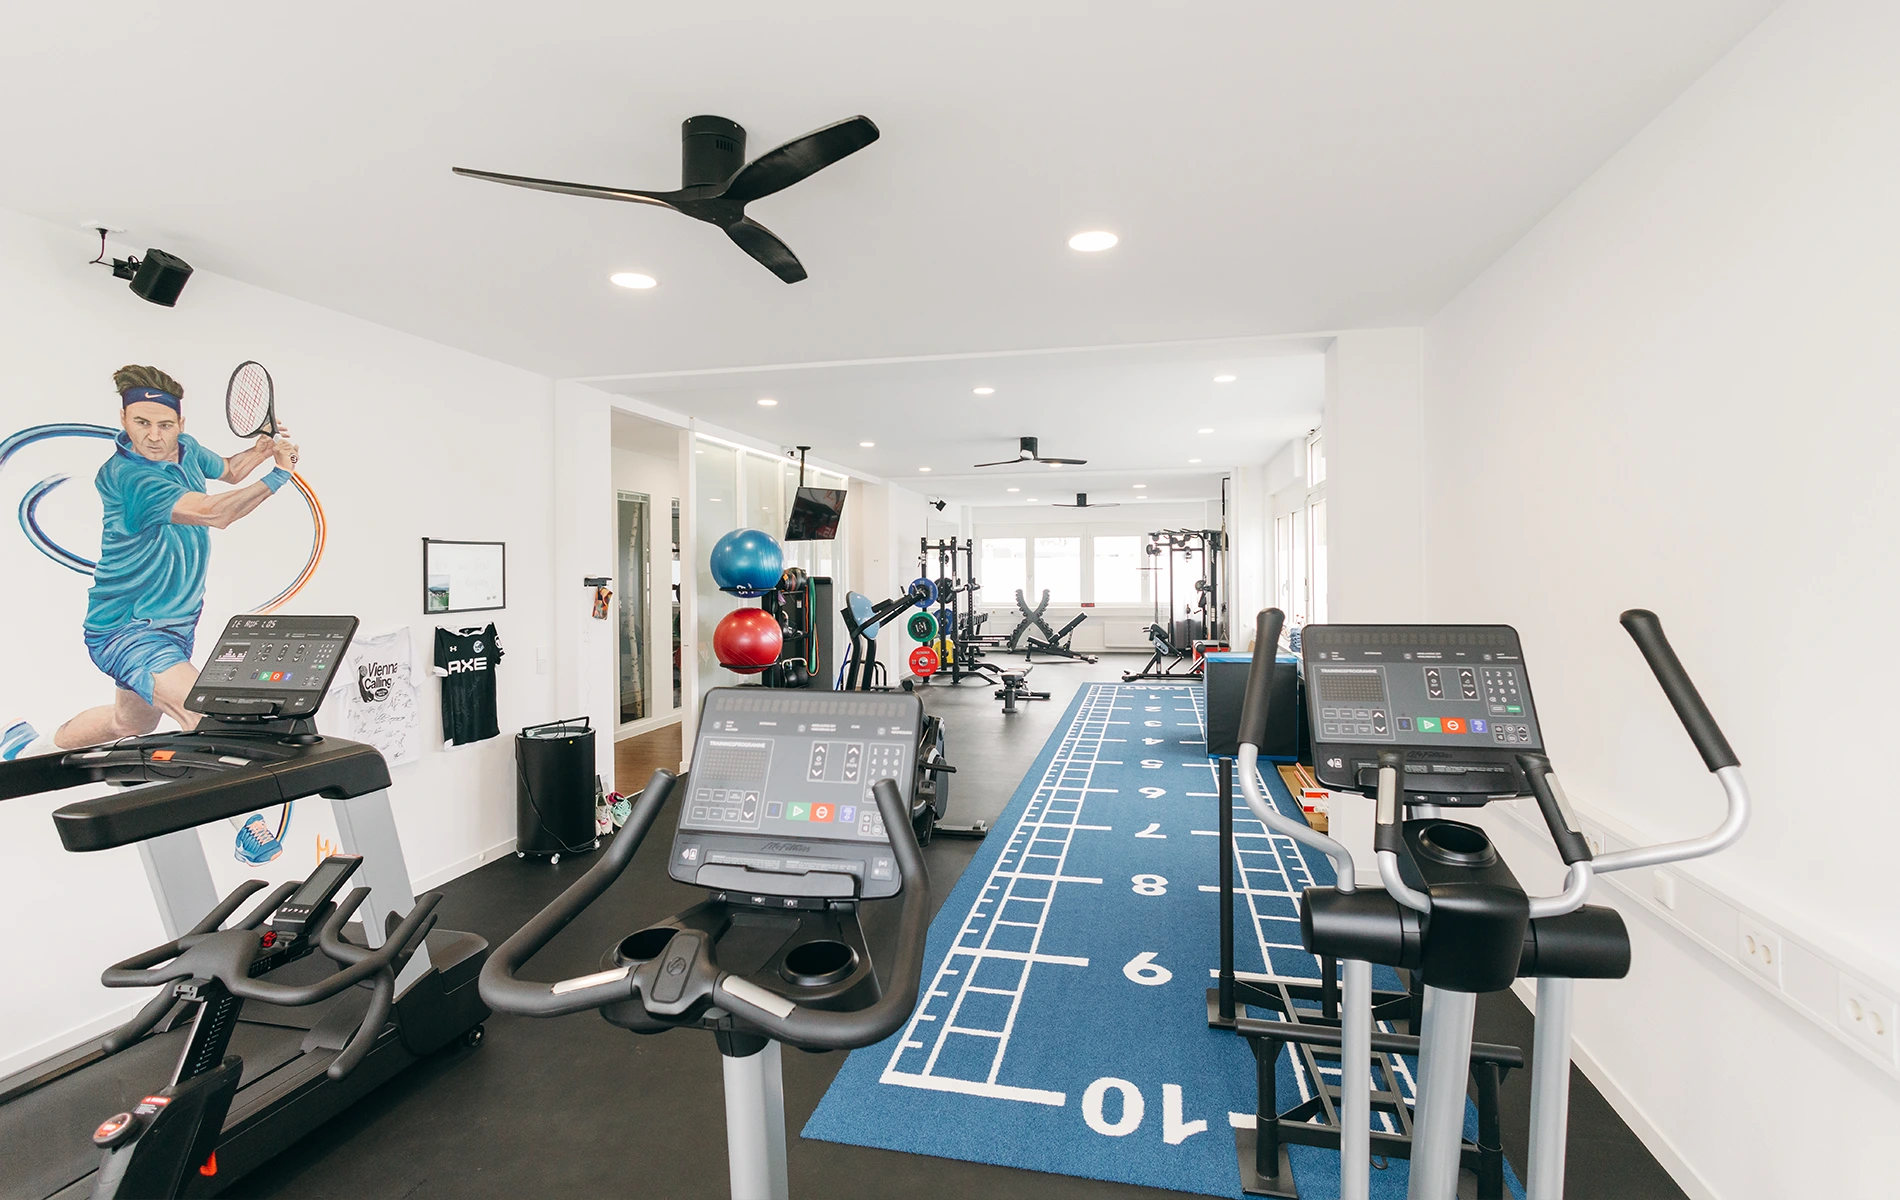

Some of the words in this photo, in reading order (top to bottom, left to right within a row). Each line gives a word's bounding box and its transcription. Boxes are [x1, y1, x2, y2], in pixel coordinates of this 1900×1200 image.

[261, 620, 278, 628] LOS
[368, 662, 398, 677] Vienna
[448, 657, 488, 674] AXE
[365, 677, 392, 690] Calling
[709, 740, 766, 749] TRAININGSPROGRAMME
[1141, 737, 1164, 745] 4
[1140, 759, 1164, 769] 5
[1138, 786, 1167, 799] 6
[1135, 823, 1166, 838] 7
[1132, 874, 1168, 895] 8
[1123, 952, 1172, 985] 9
[1082, 1077, 1207, 1144] 10
